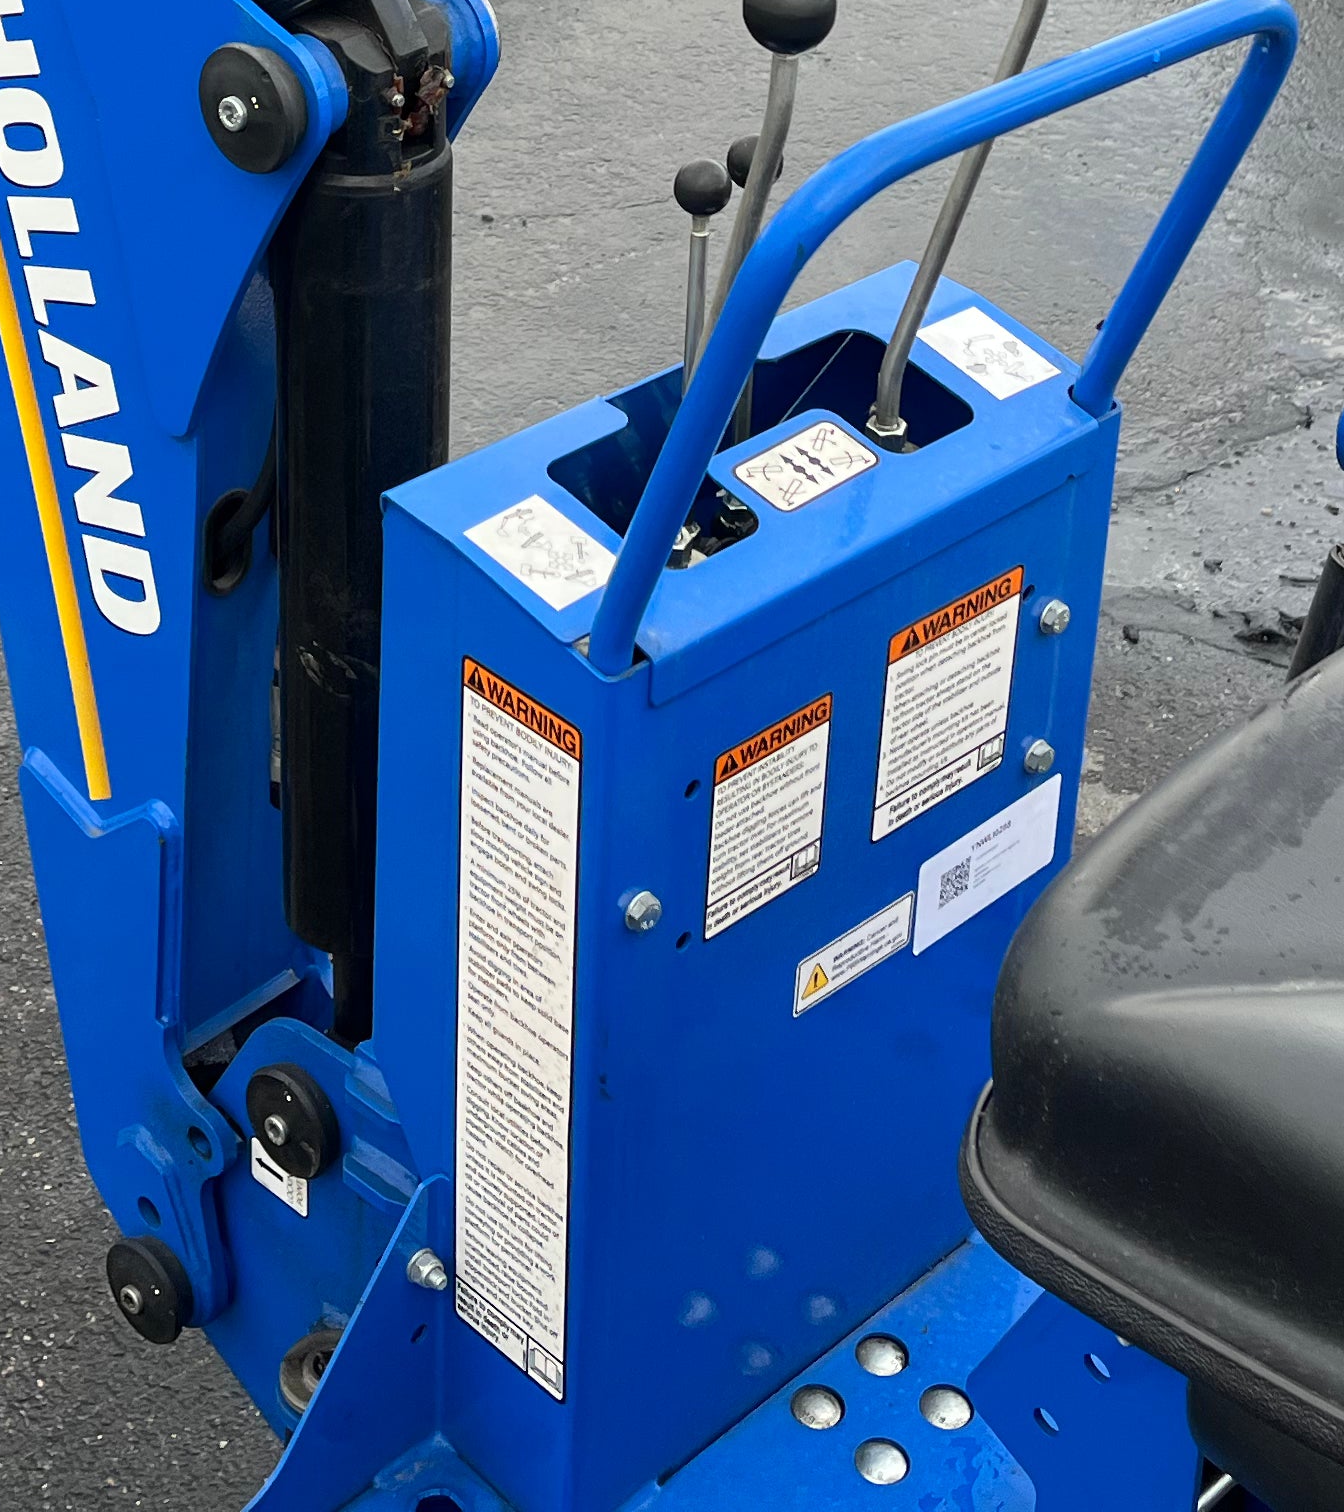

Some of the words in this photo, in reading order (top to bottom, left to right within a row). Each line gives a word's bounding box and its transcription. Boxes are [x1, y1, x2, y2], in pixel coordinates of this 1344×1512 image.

[922, 575, 1012, 641] WARNING
[487, 677, 576, 755] WARNING
[739, 699, 827, 767] WARNING
